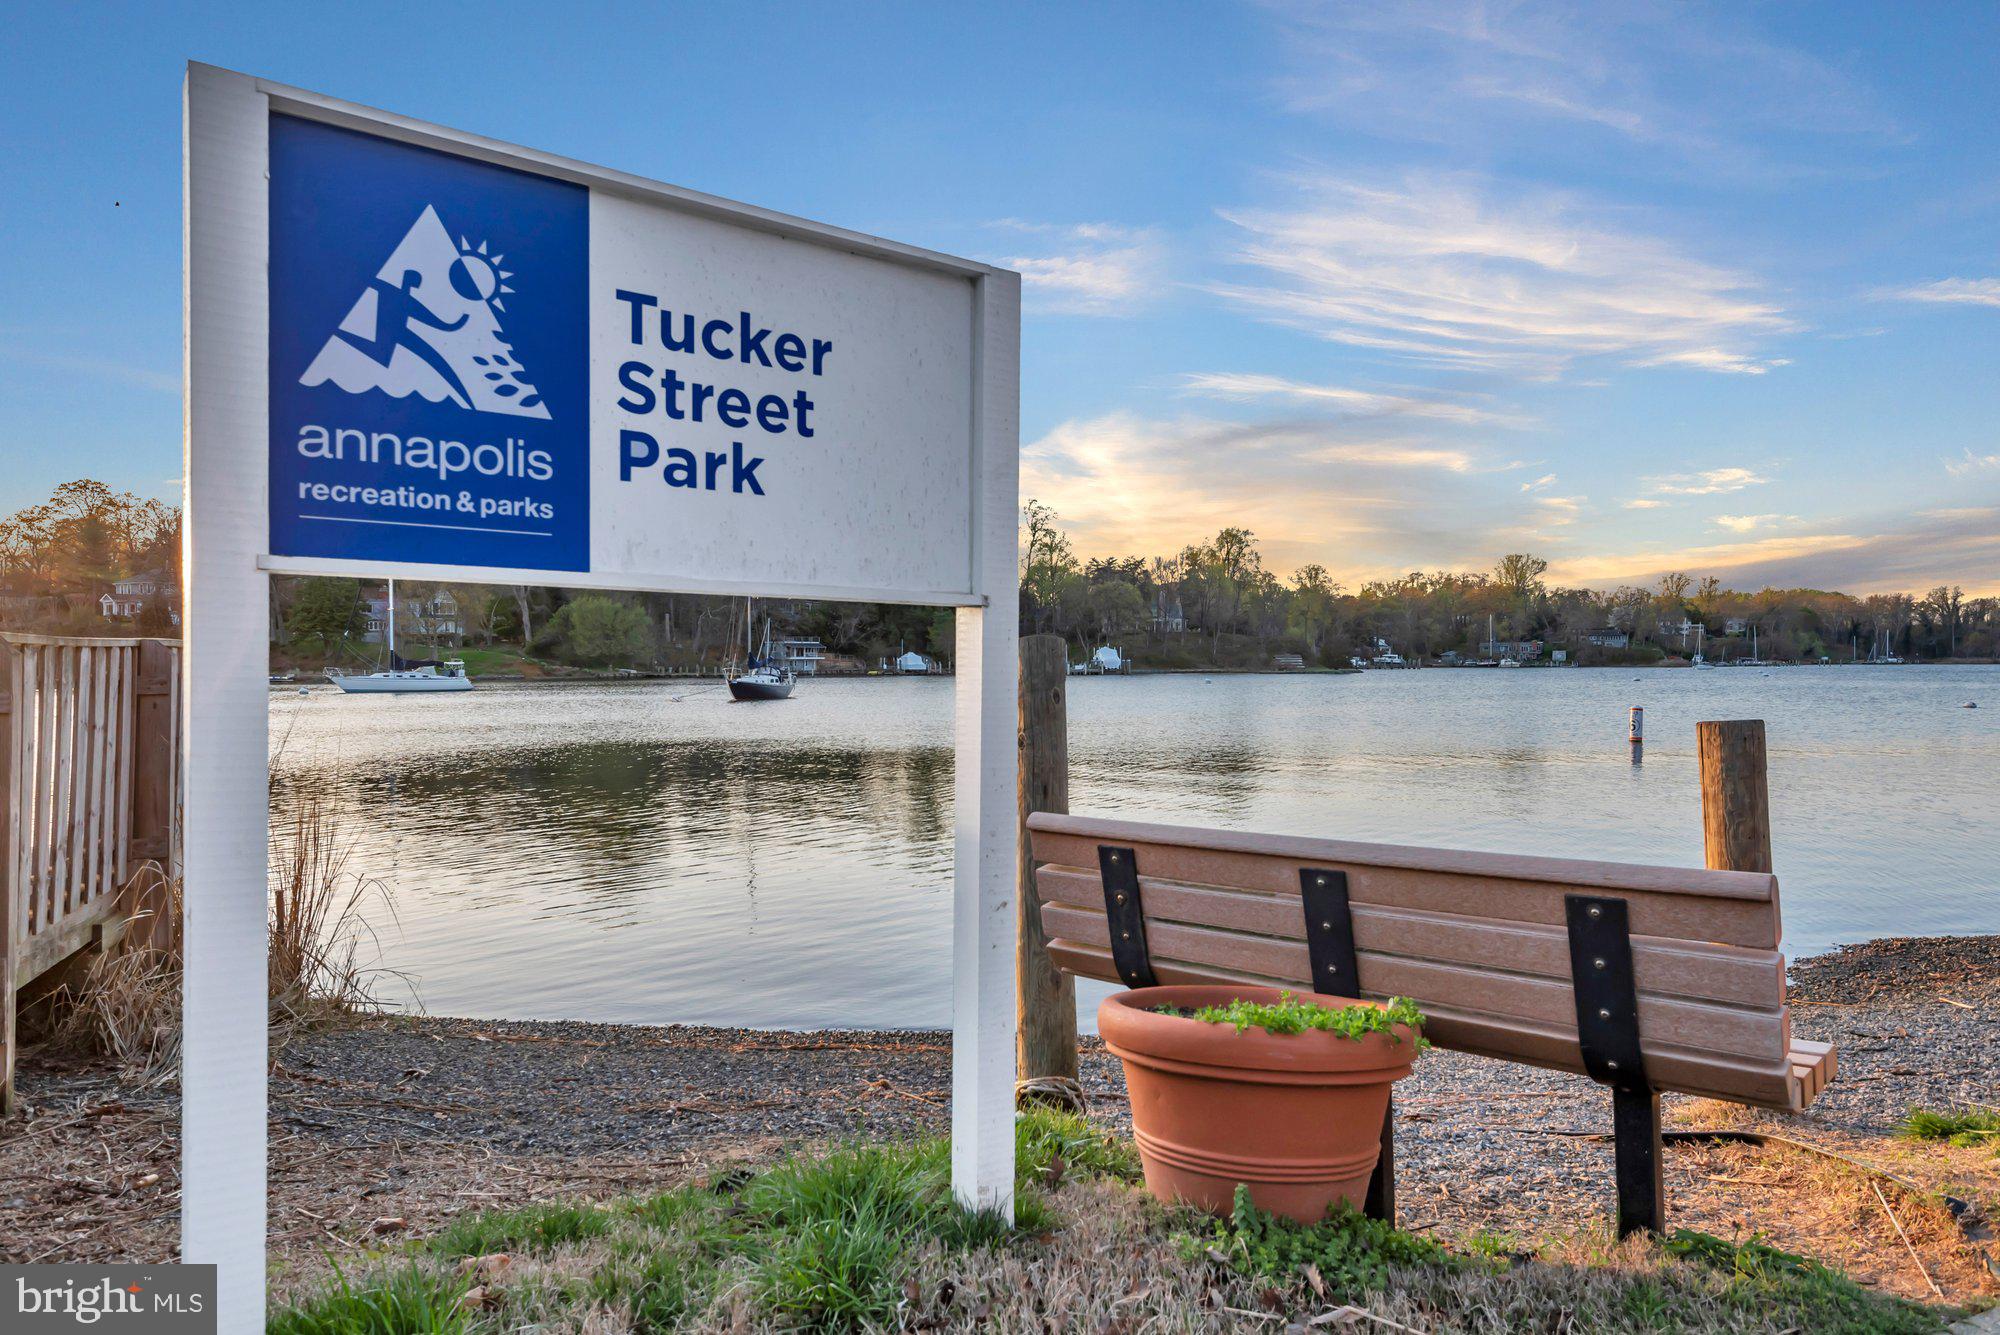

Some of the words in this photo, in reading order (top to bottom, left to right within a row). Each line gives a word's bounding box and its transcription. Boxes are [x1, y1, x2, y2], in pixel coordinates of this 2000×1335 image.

[616, 289, 833, 376] Tucker
[617, 361, 815, 438] Street
[298, 424, 553, 481] annapolis
[620, 429, 765, 496] Park
[299, 480, 452, 513] recreation
[456, 490, 476, 513] &
[480, 498, 554, 519] parks
